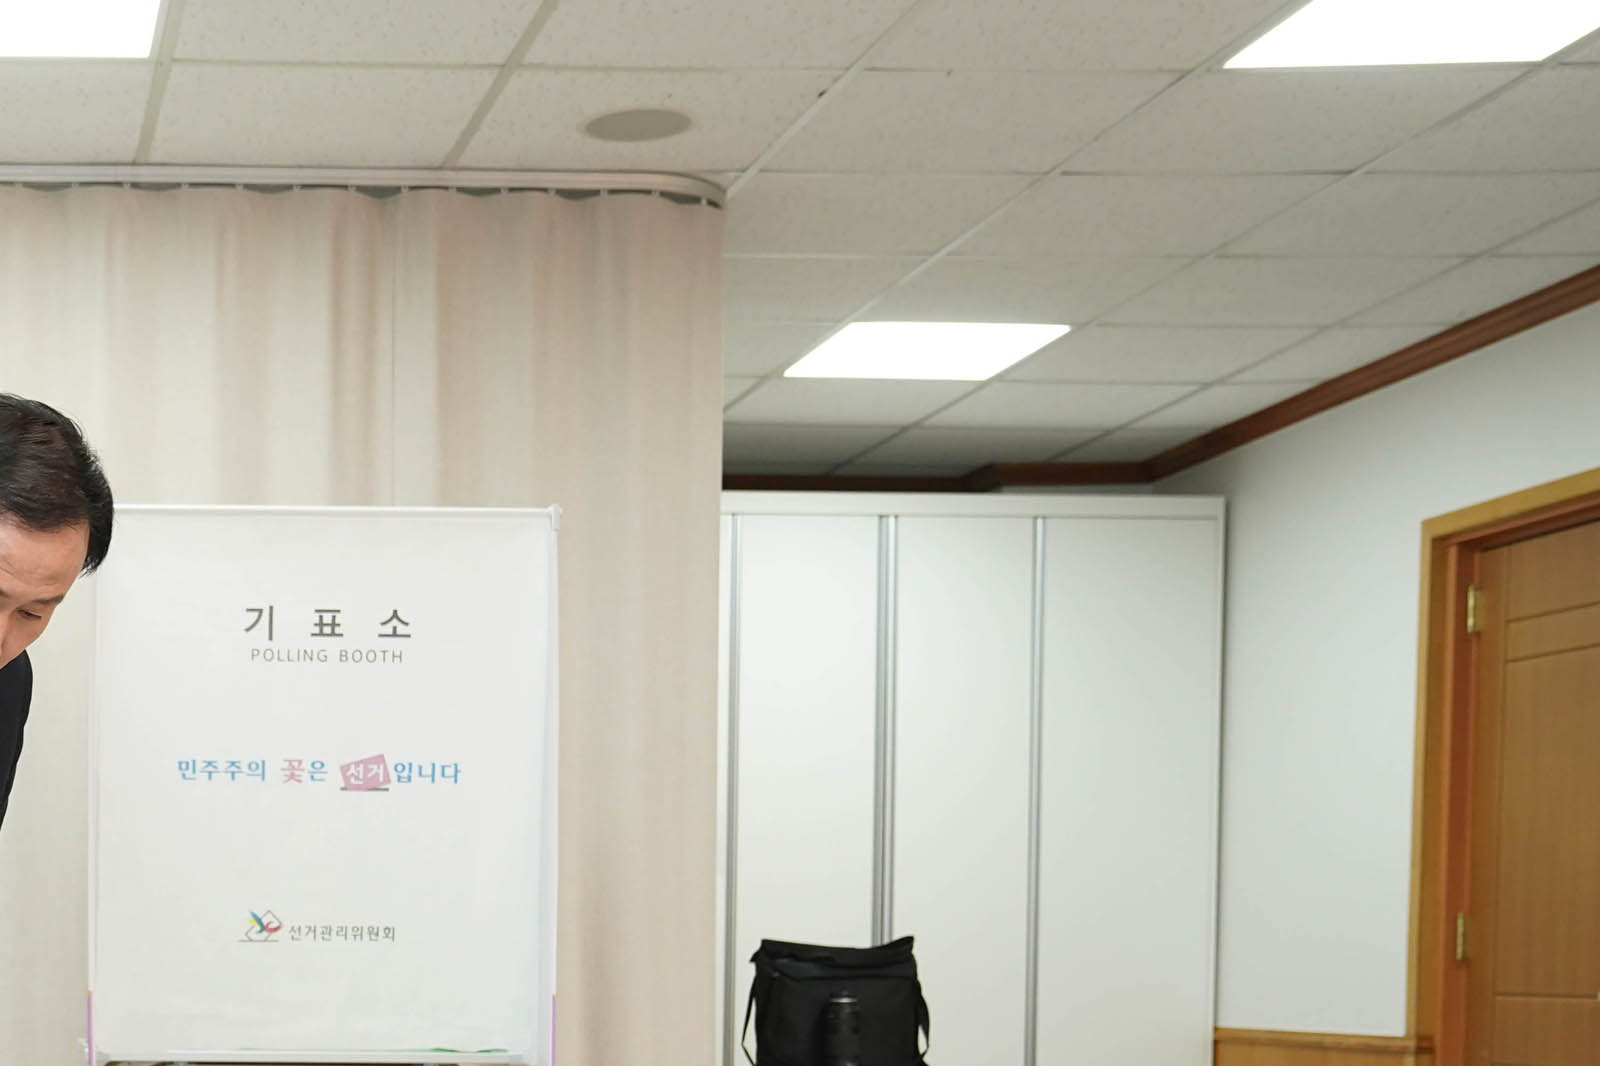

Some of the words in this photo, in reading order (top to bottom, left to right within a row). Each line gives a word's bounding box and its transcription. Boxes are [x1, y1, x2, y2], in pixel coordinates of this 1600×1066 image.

[252, 648, 327, 662] POLLING
[339, 650, 402, 663] BOOTH
[178, 760, 265, 781] 민주주의
[282, 760, 327, 783] 꽃은
[343, 761, 461, 785] 선거입니다
[290, 926, 395, 942] 선거관리위원회
